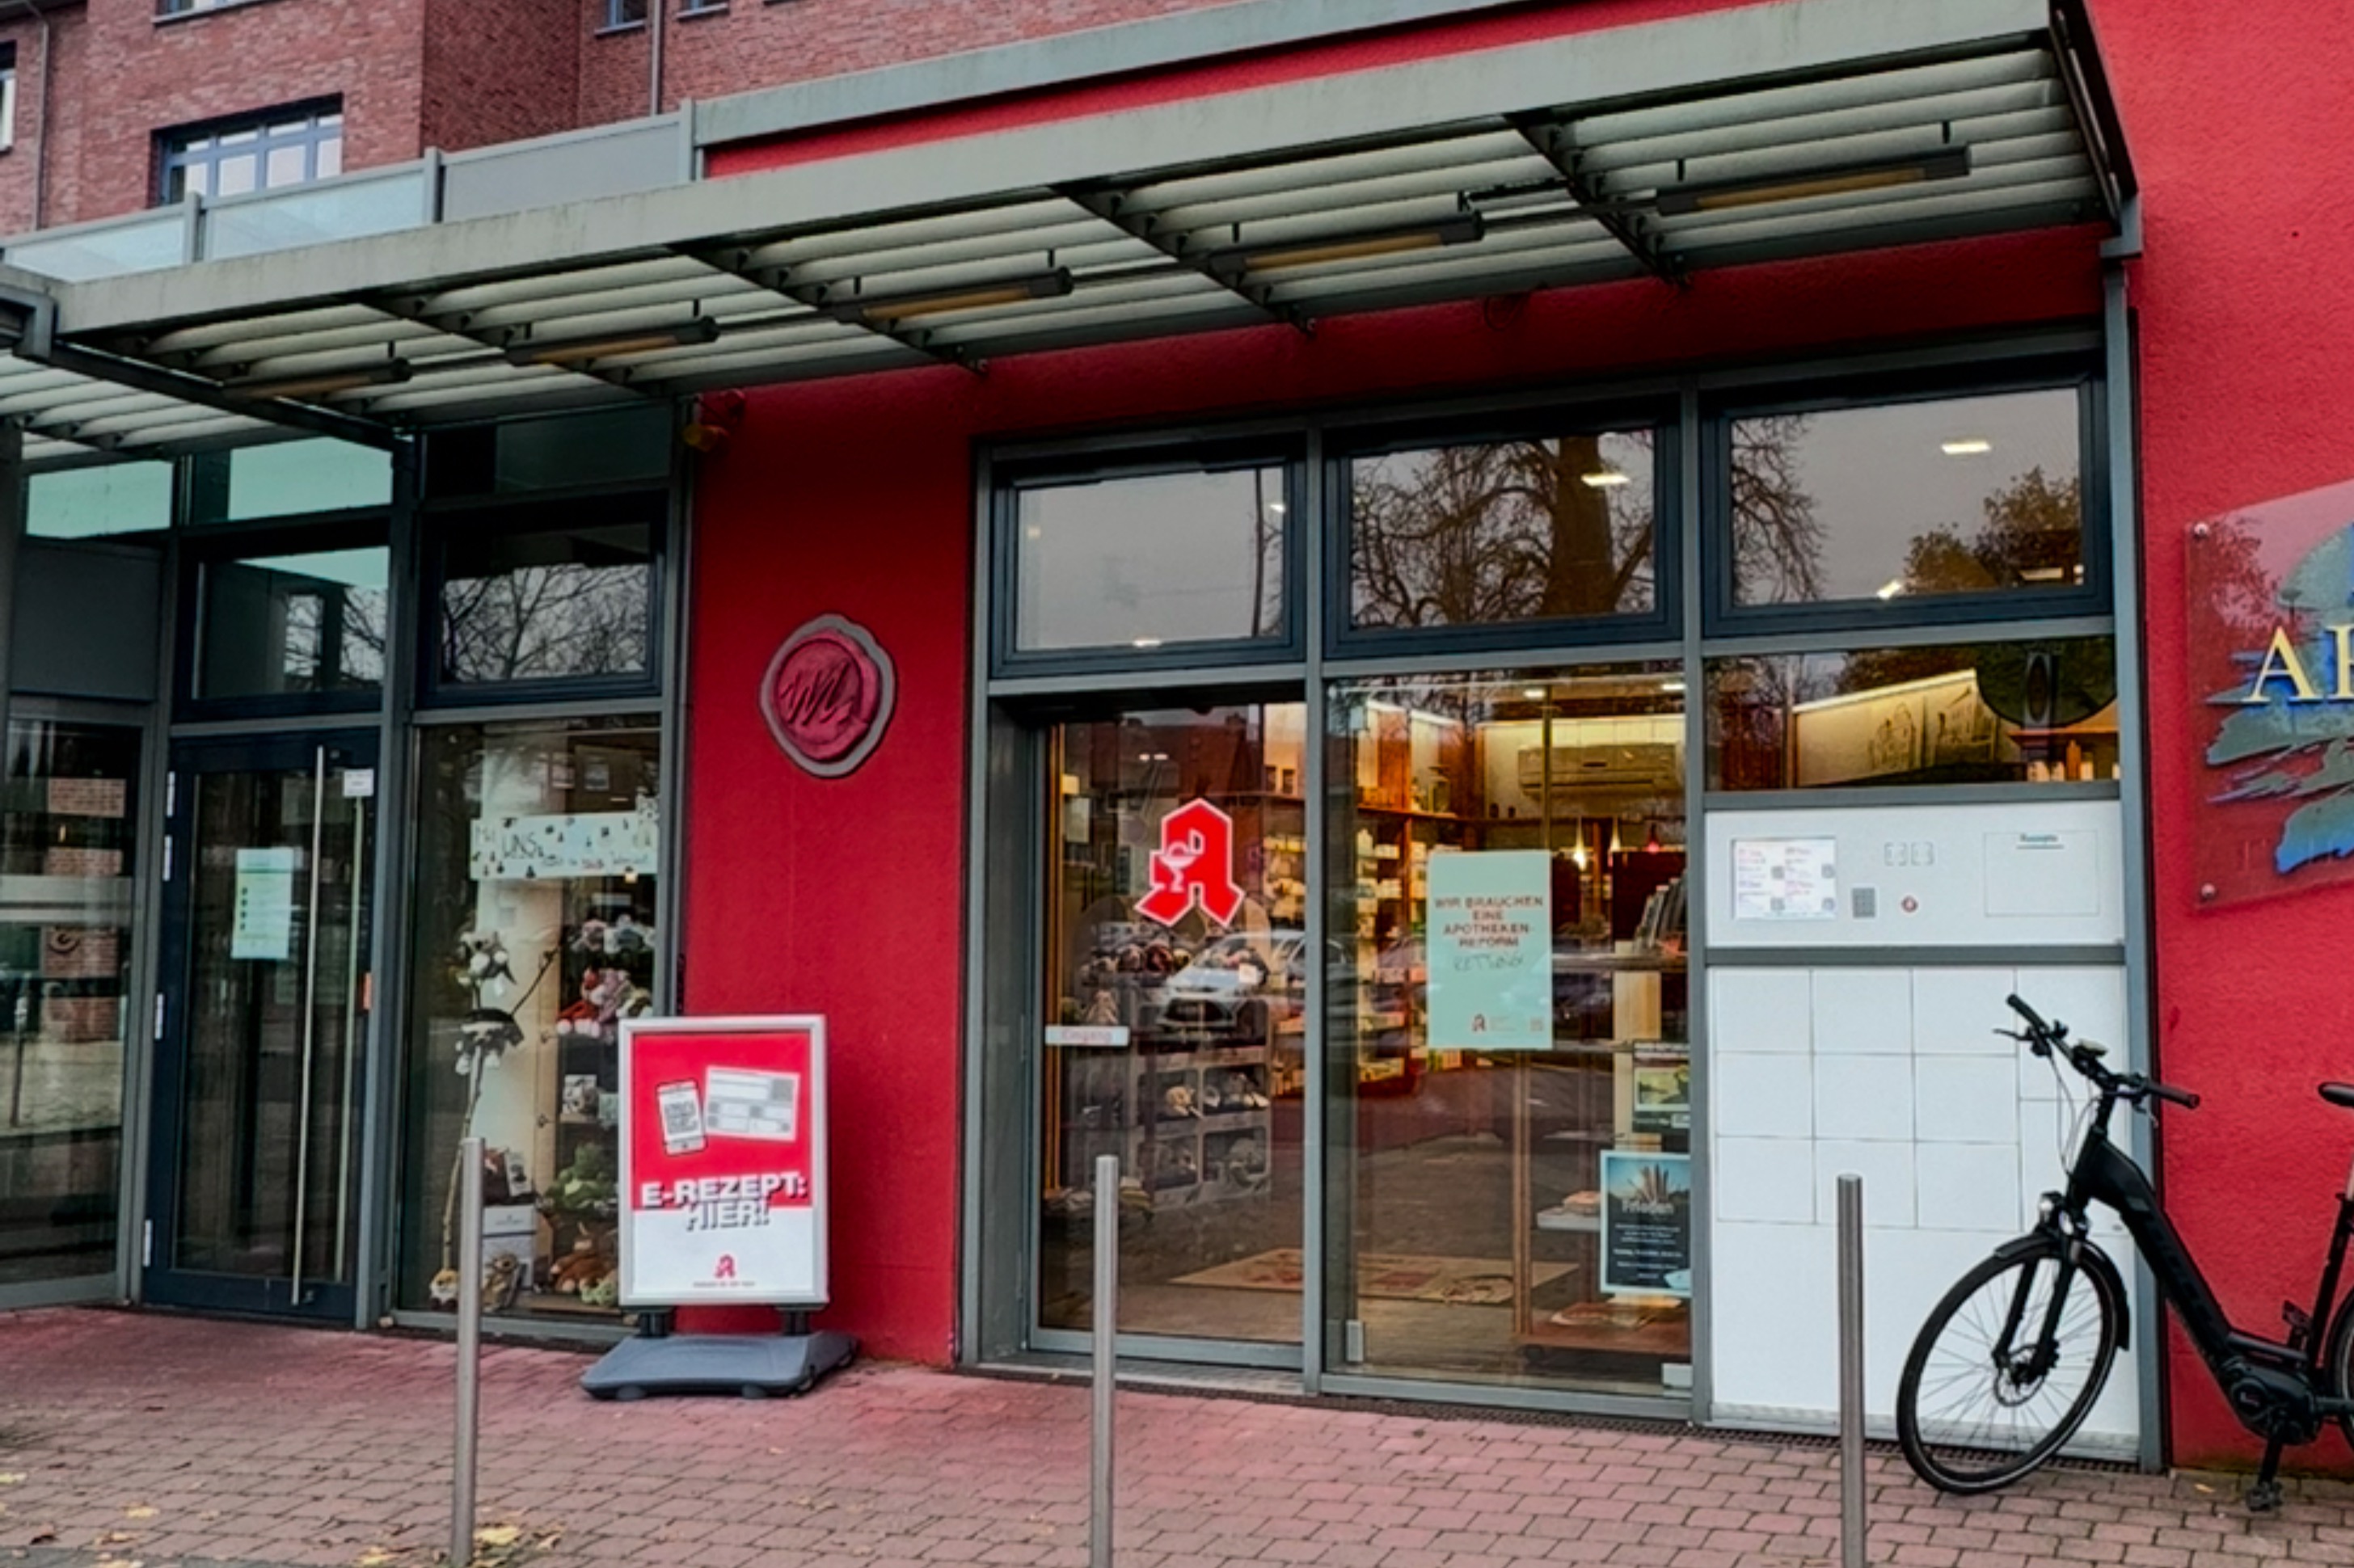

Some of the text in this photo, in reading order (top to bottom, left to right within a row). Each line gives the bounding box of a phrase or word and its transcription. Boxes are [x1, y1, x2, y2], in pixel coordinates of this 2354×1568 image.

[1436, 896, 1543, 908] WIR BRAUCHEN
[1473, 910, 1502, 920] EINE
[1459, 938, 1519, 947] REFORM
[642, 1171, 808, 1209] E-REZEPT:
